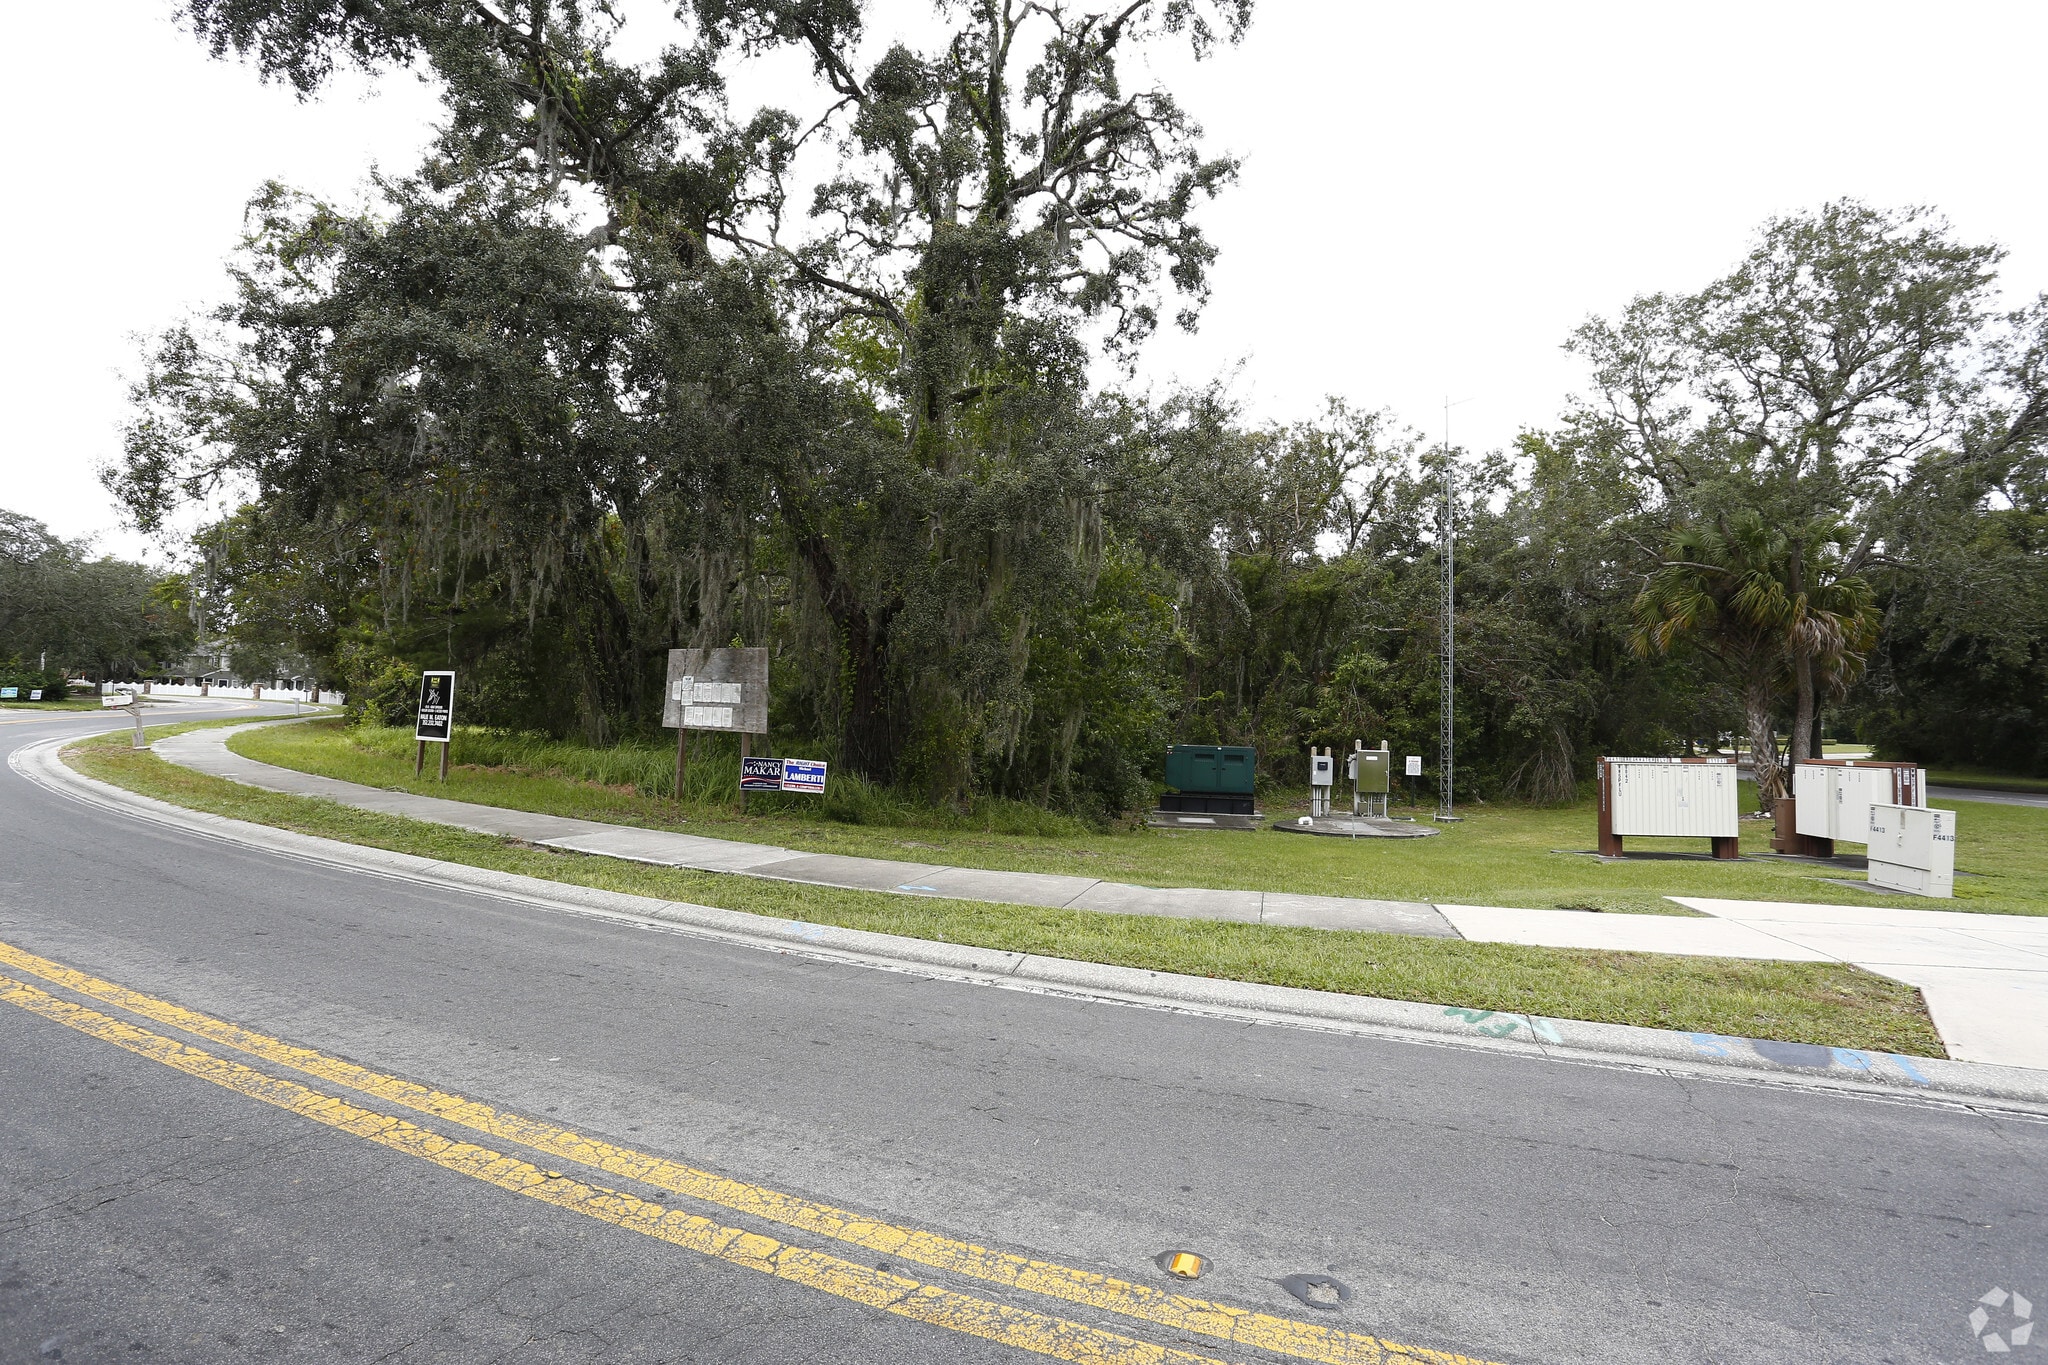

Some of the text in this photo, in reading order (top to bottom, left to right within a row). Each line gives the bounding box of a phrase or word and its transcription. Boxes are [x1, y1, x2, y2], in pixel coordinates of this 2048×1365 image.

[744, 766, 780, 776] MAKAR
[785, 772, 824, 783] LAMBERTI
[1933, 834, 1955, 842] F4413
